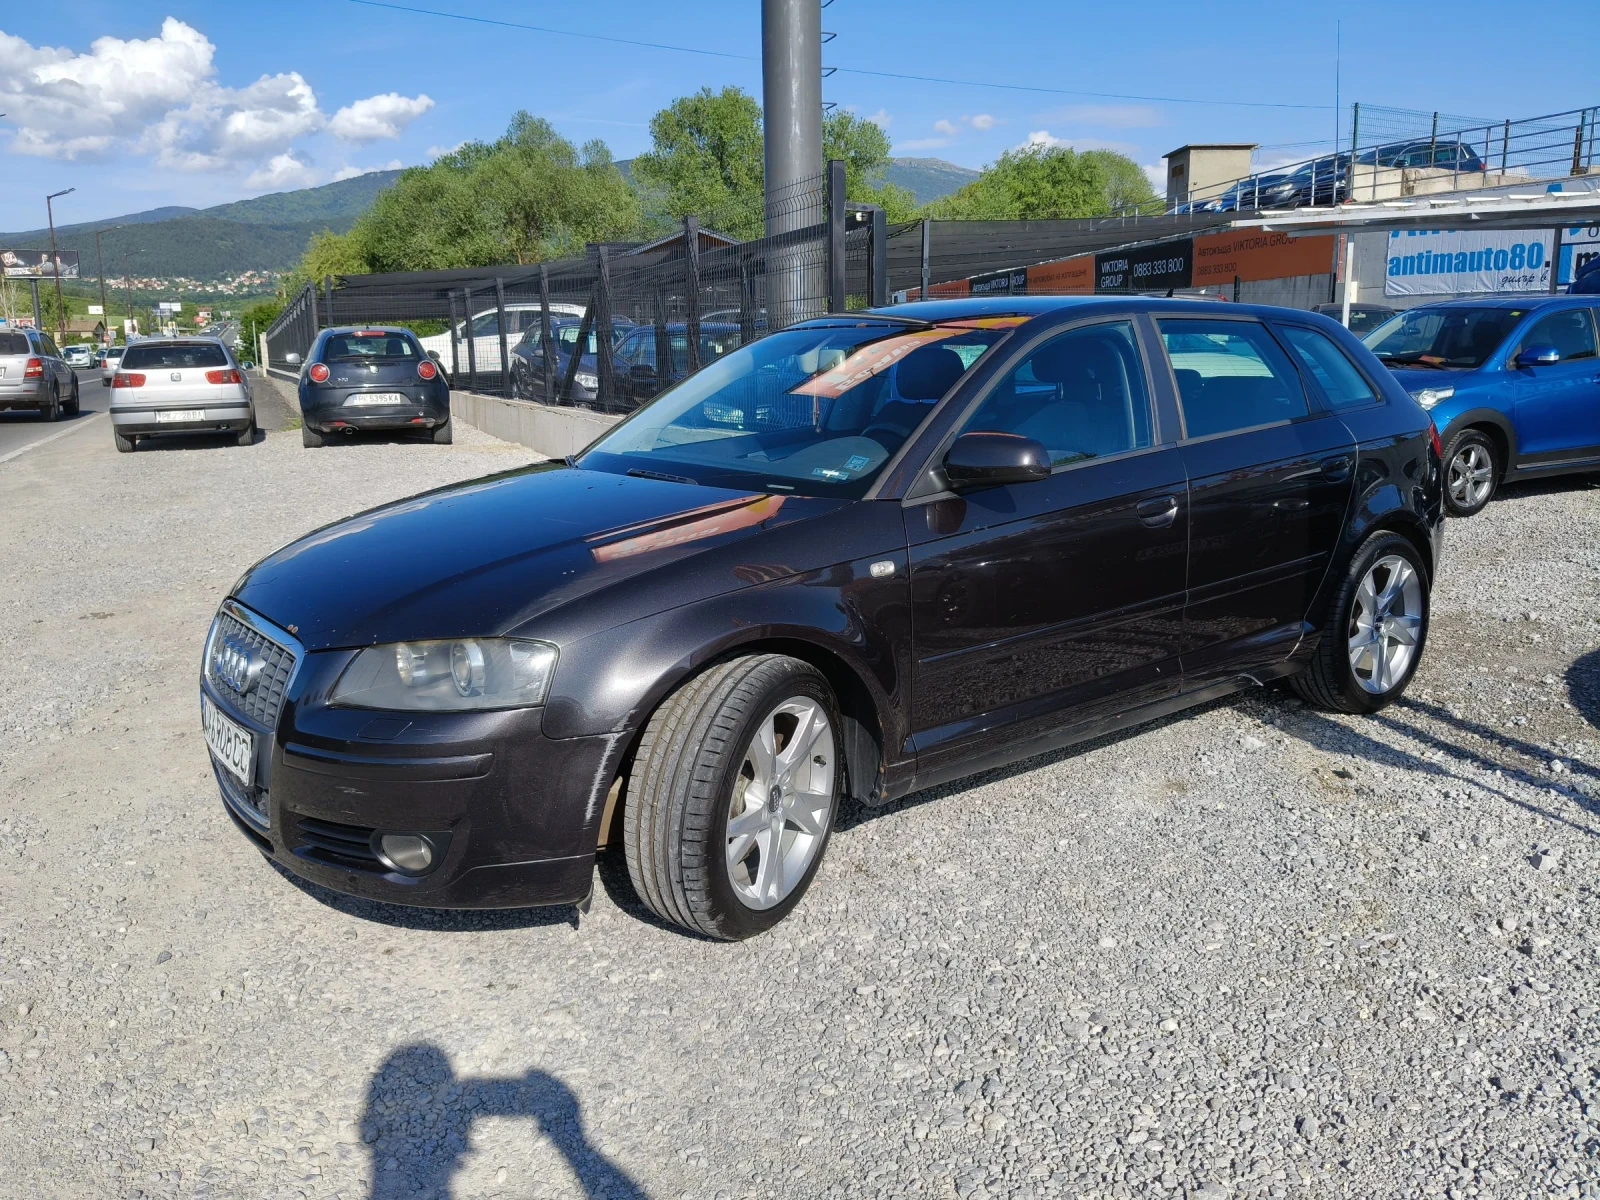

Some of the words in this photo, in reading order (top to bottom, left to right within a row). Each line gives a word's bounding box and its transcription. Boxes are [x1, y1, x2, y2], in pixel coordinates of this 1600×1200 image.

[1233, 236, 1268, 252] VIKTORIA
[1101, 259, 1128, 273] VIKTORIA
[1133, 262, 1152, 277] 0883
[1152, 260, 1166, 275] 333
[1167, 257, 1184, 273] 800
[1388, 242, 1551, 277] antimauto80.
[1101, 274, 1123, 288] GROUP
